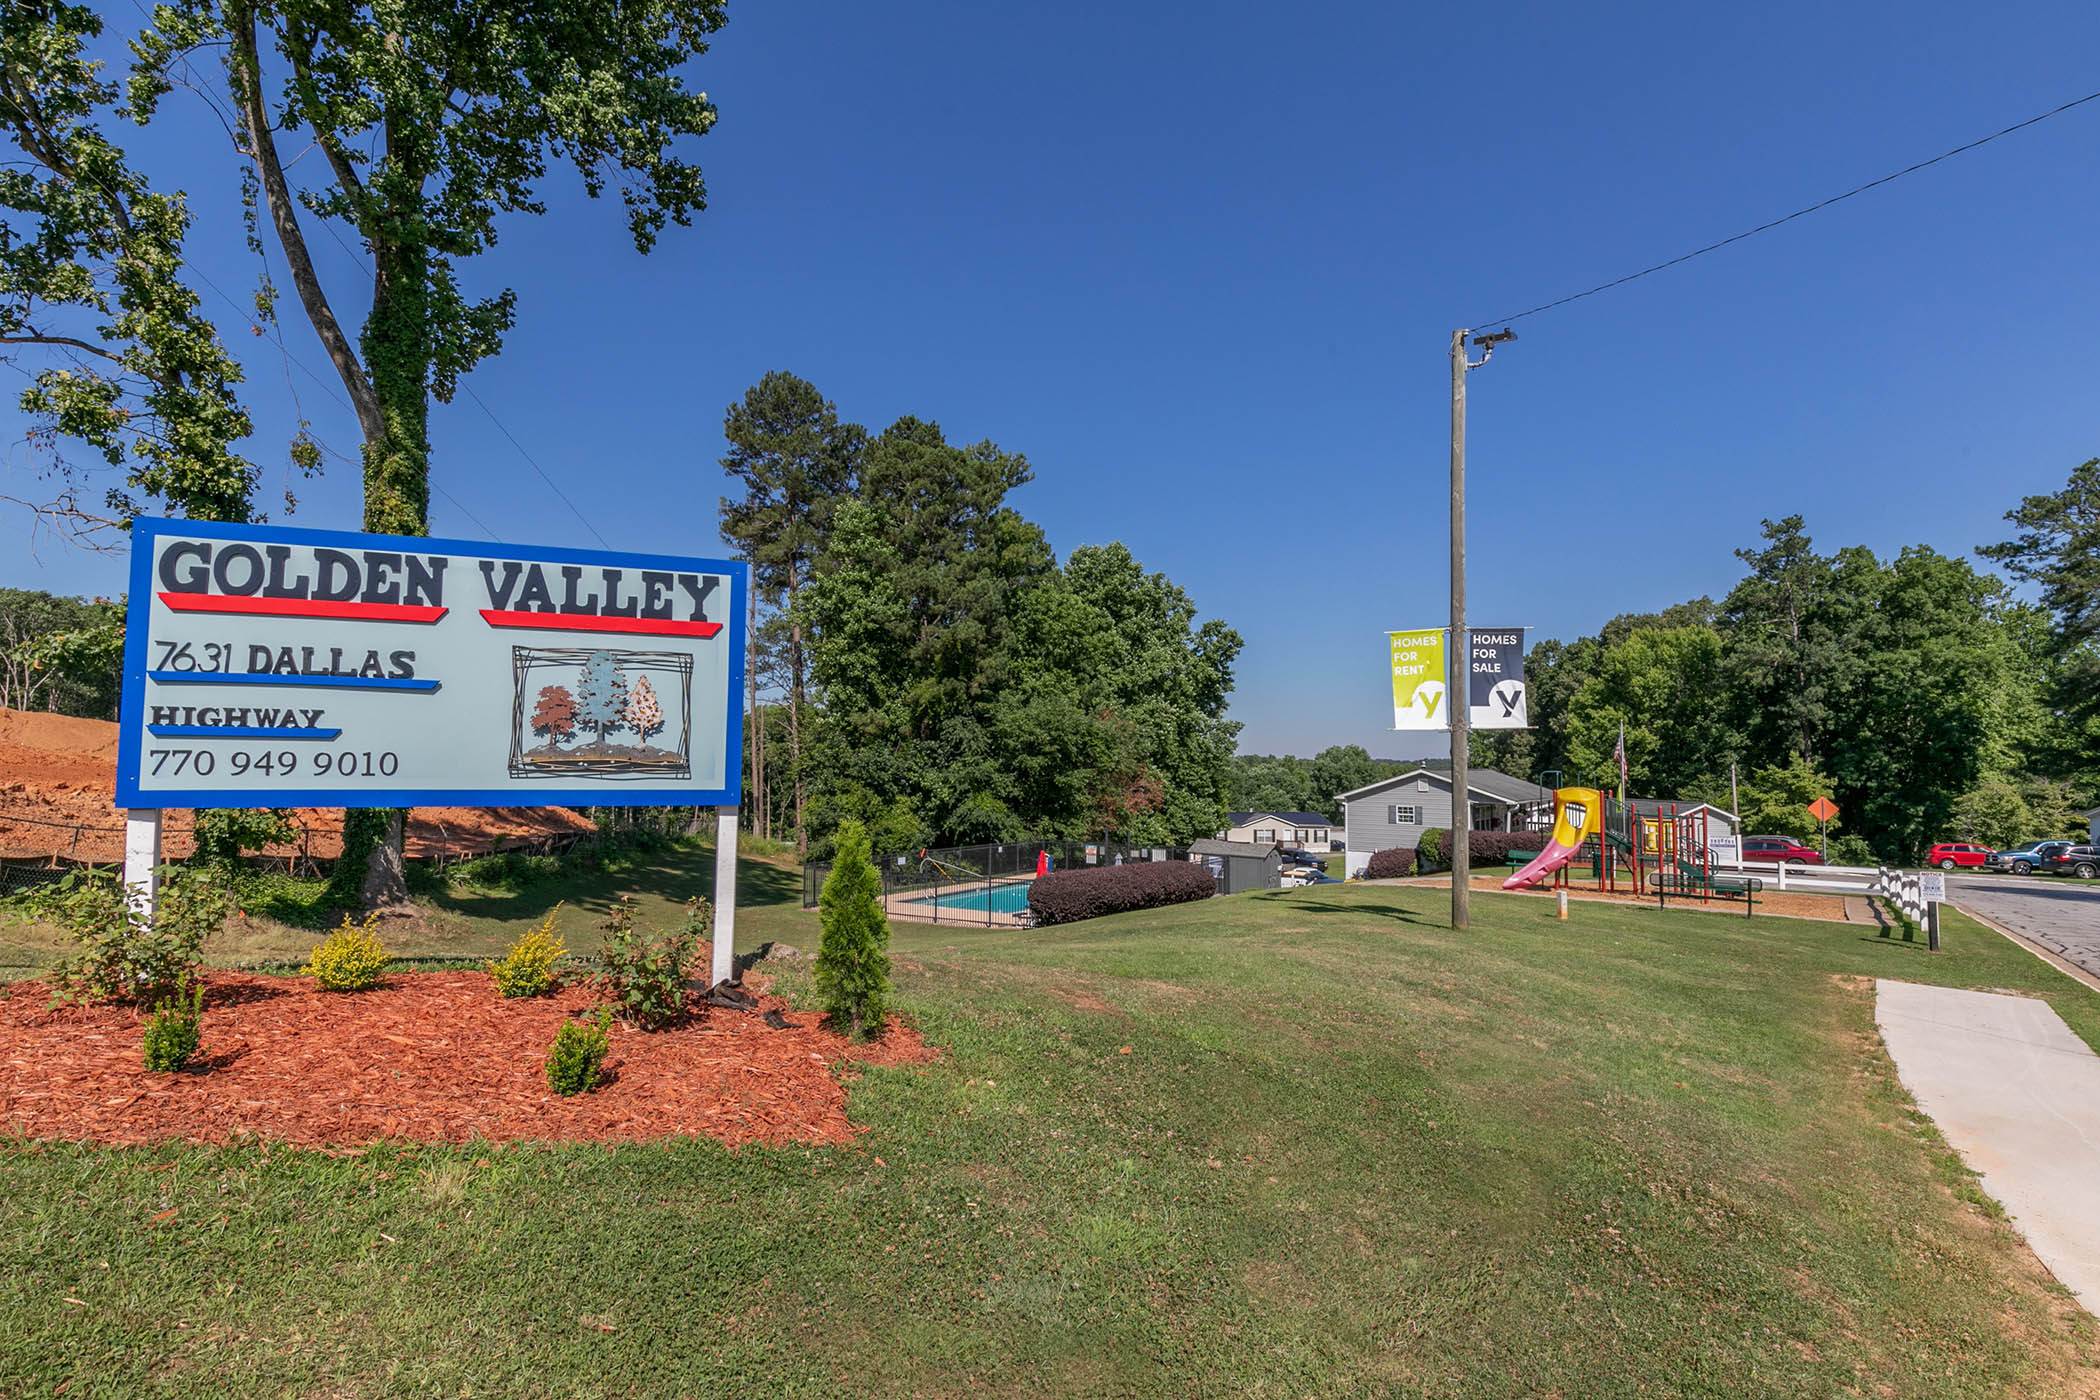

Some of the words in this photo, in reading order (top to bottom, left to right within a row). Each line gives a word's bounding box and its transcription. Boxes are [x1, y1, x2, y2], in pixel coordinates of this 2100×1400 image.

[159, 541, 448, 607] GOLDEN
[479, 560, 720, 622] VALLEY
[1393, 636, 1437, 648] HOMES
[1473, 635, 1517, 645] HOMES
[154, 640, 232, 673] 7631
[247, 644, 416, 679] DALLAS
[1394, 651, 1418, 662] FOR
[1473, 649, 1497, 659] FOR
[1394, 664, 1425, 676] RENT
[1472, 662, 1502, 673] SALE
[150, 706, 325, 729] HIGHWAY
[150, 750, 215, 776] 770
[230, 751, 297, 776] 949
[313, 751, 399, 777] 9010
